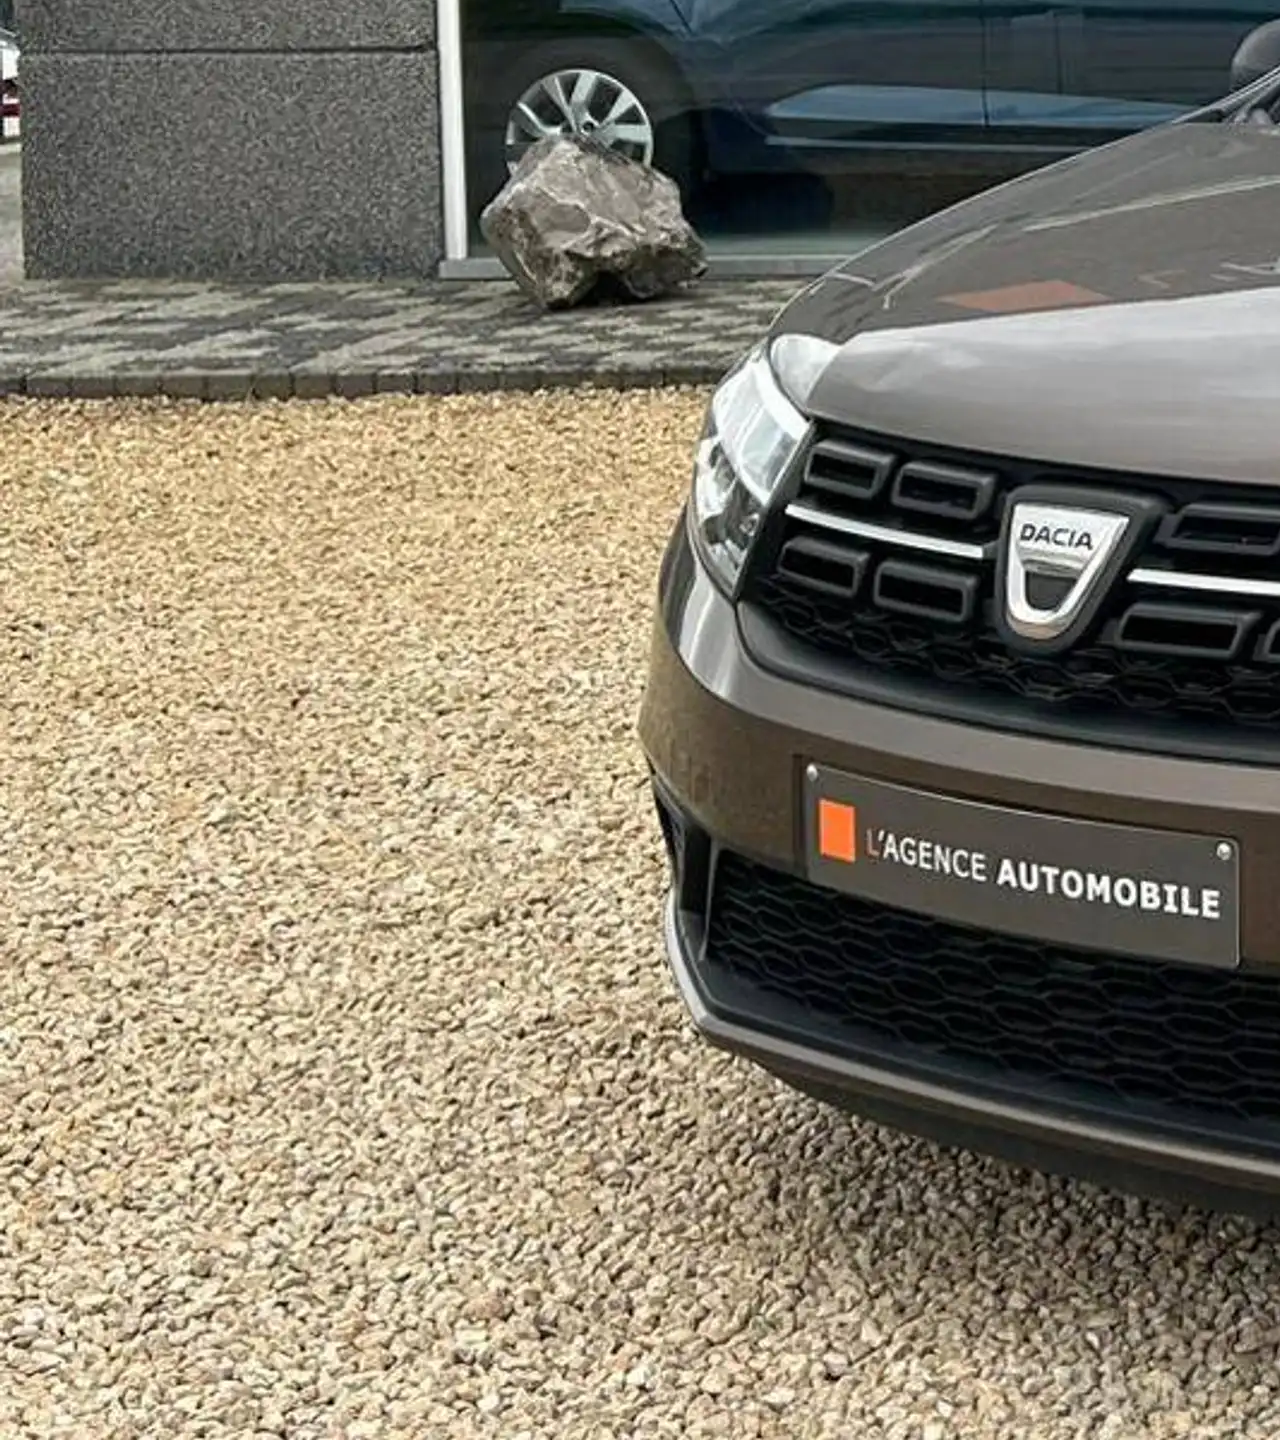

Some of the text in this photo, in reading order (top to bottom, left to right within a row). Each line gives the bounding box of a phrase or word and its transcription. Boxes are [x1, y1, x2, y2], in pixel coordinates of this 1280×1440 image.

[1019, 522, 1093, 550] DACIA
[865, 828, 1222, 920] L'AGENCE AUTOMOBILE
